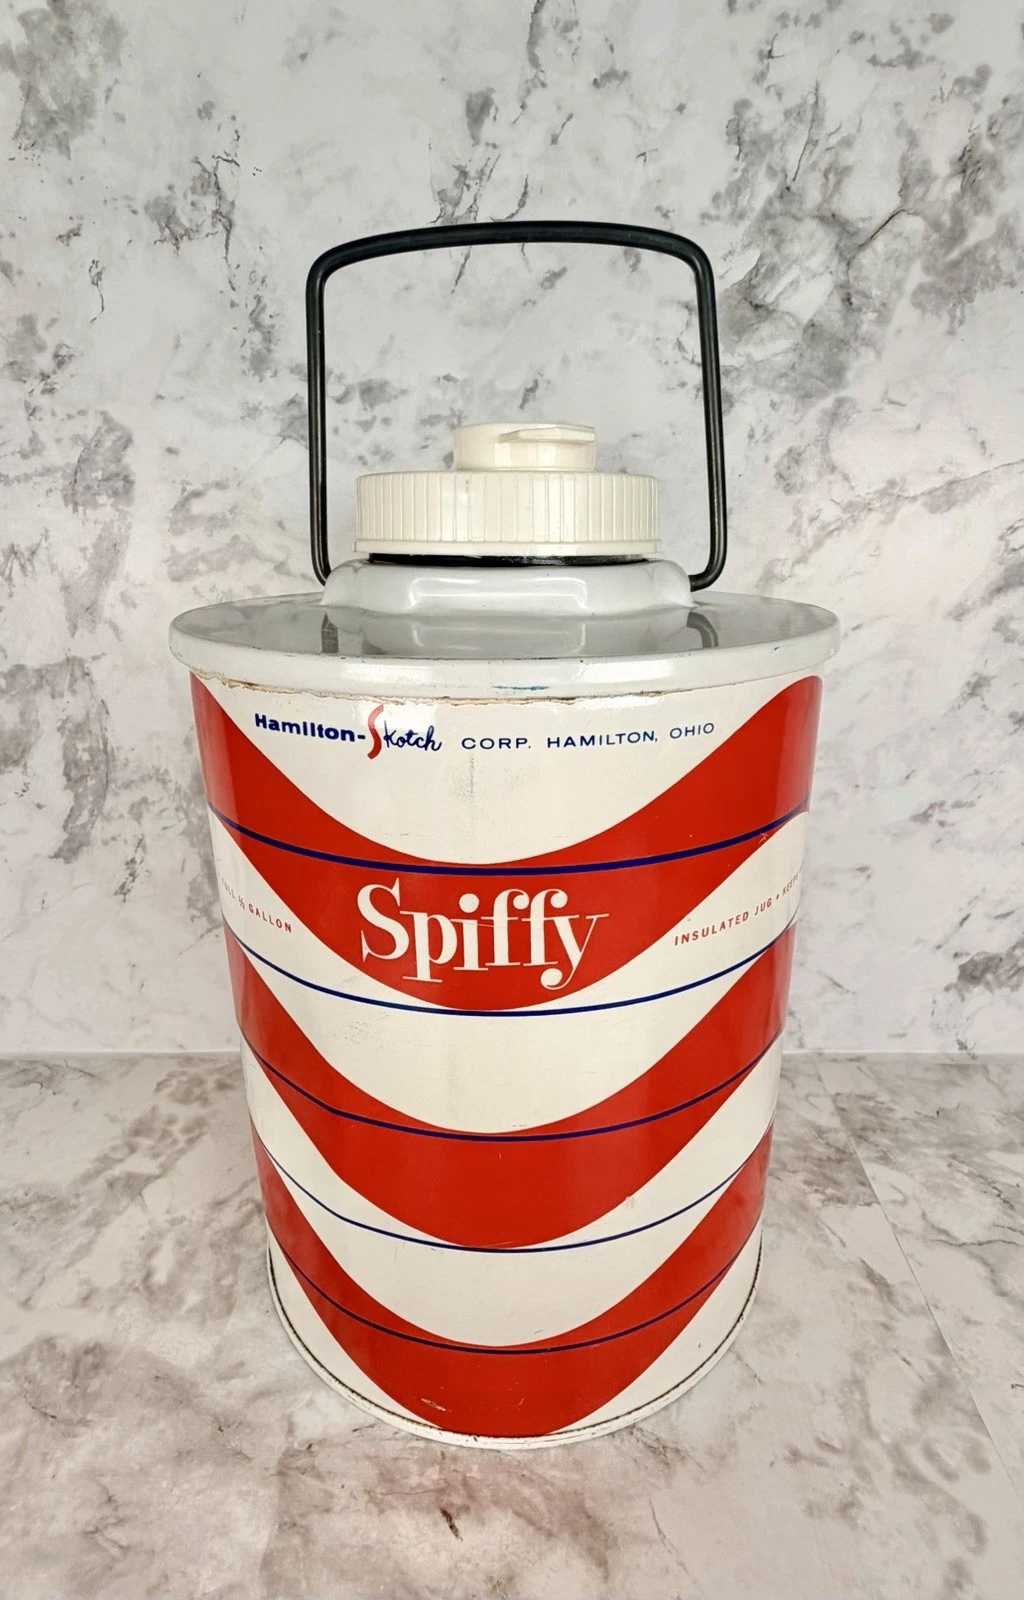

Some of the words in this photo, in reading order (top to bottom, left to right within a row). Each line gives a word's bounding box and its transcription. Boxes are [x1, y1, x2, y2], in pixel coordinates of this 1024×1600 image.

[461, 737, 531, 750] CORP.
[547, 730, 658, 748] HAMILTON,
[669, 722, 715, 740] OHIO
[248, 903, 292, 933] GALLON
[357, 877, 609, 990] Spiffy
[674, 911, 749, 946] INSULATED
[754, 898, 772, 916] JUG
